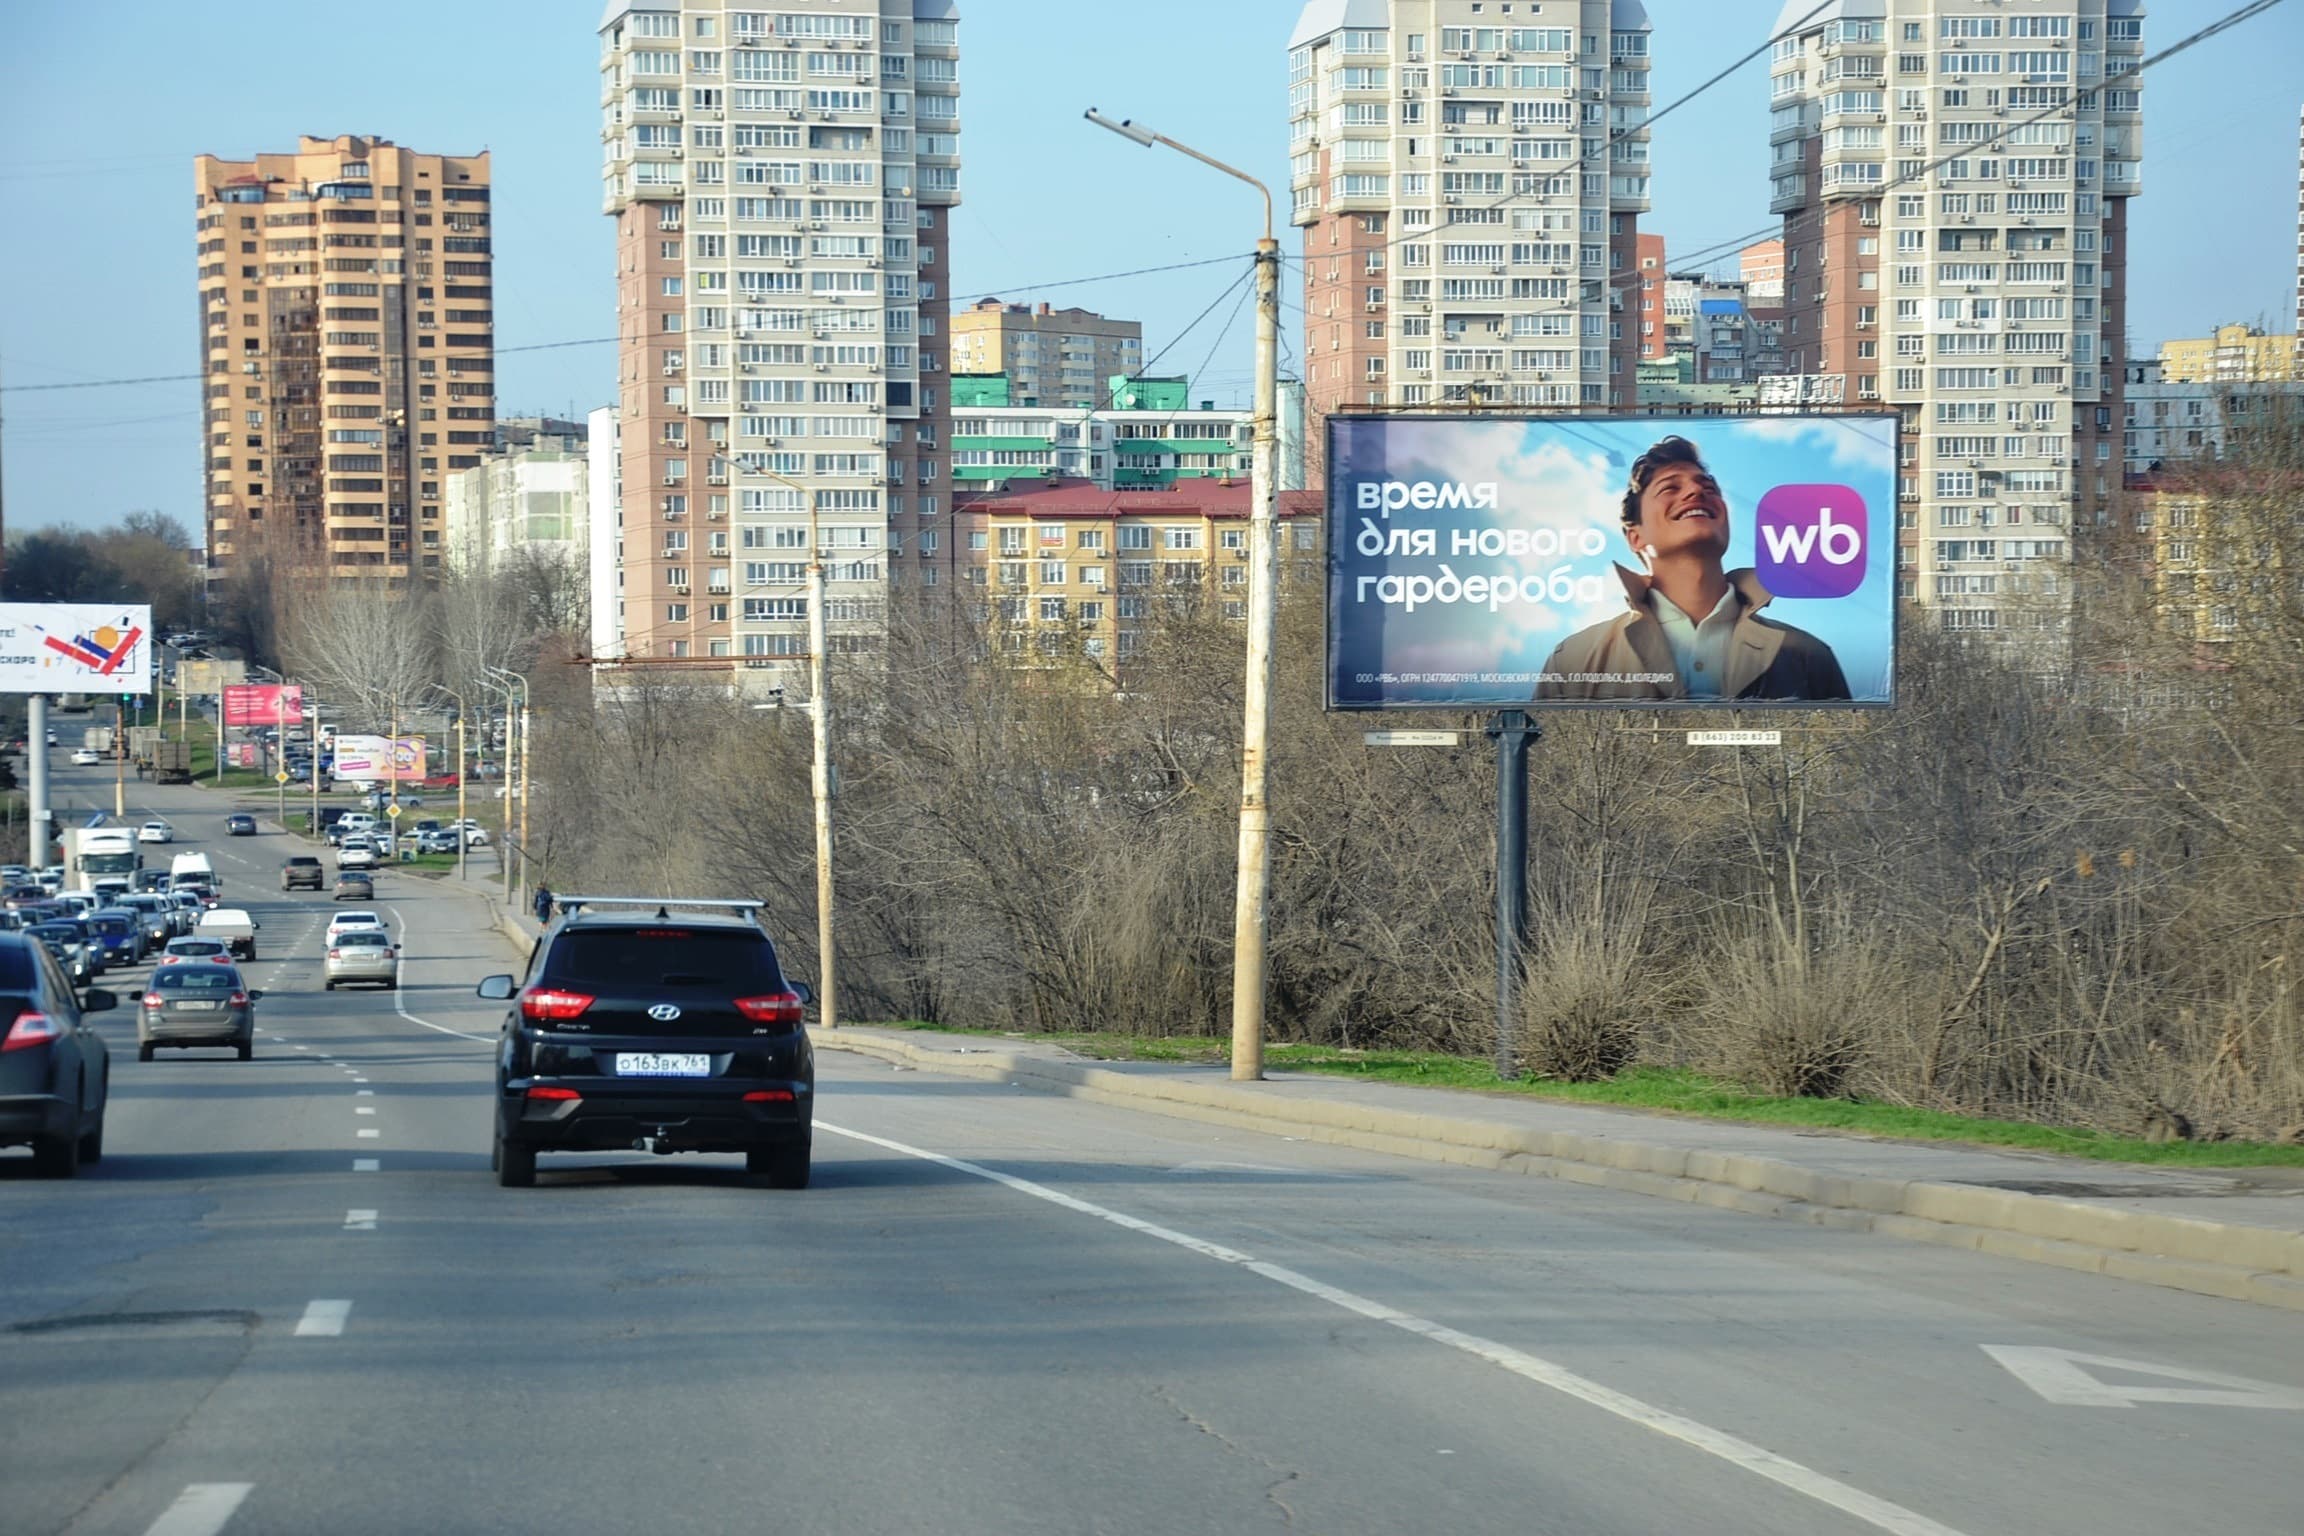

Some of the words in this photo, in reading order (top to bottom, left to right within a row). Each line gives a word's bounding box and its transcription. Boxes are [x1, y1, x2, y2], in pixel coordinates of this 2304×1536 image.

[1357, 480, 1498, 519] время
[1356, 517, 1437, 557] для
[1451, 527, 1607, 557] нового
[1761, 507, 1861, 565] wb
[1357, 564, 1605, 613] гардероба
